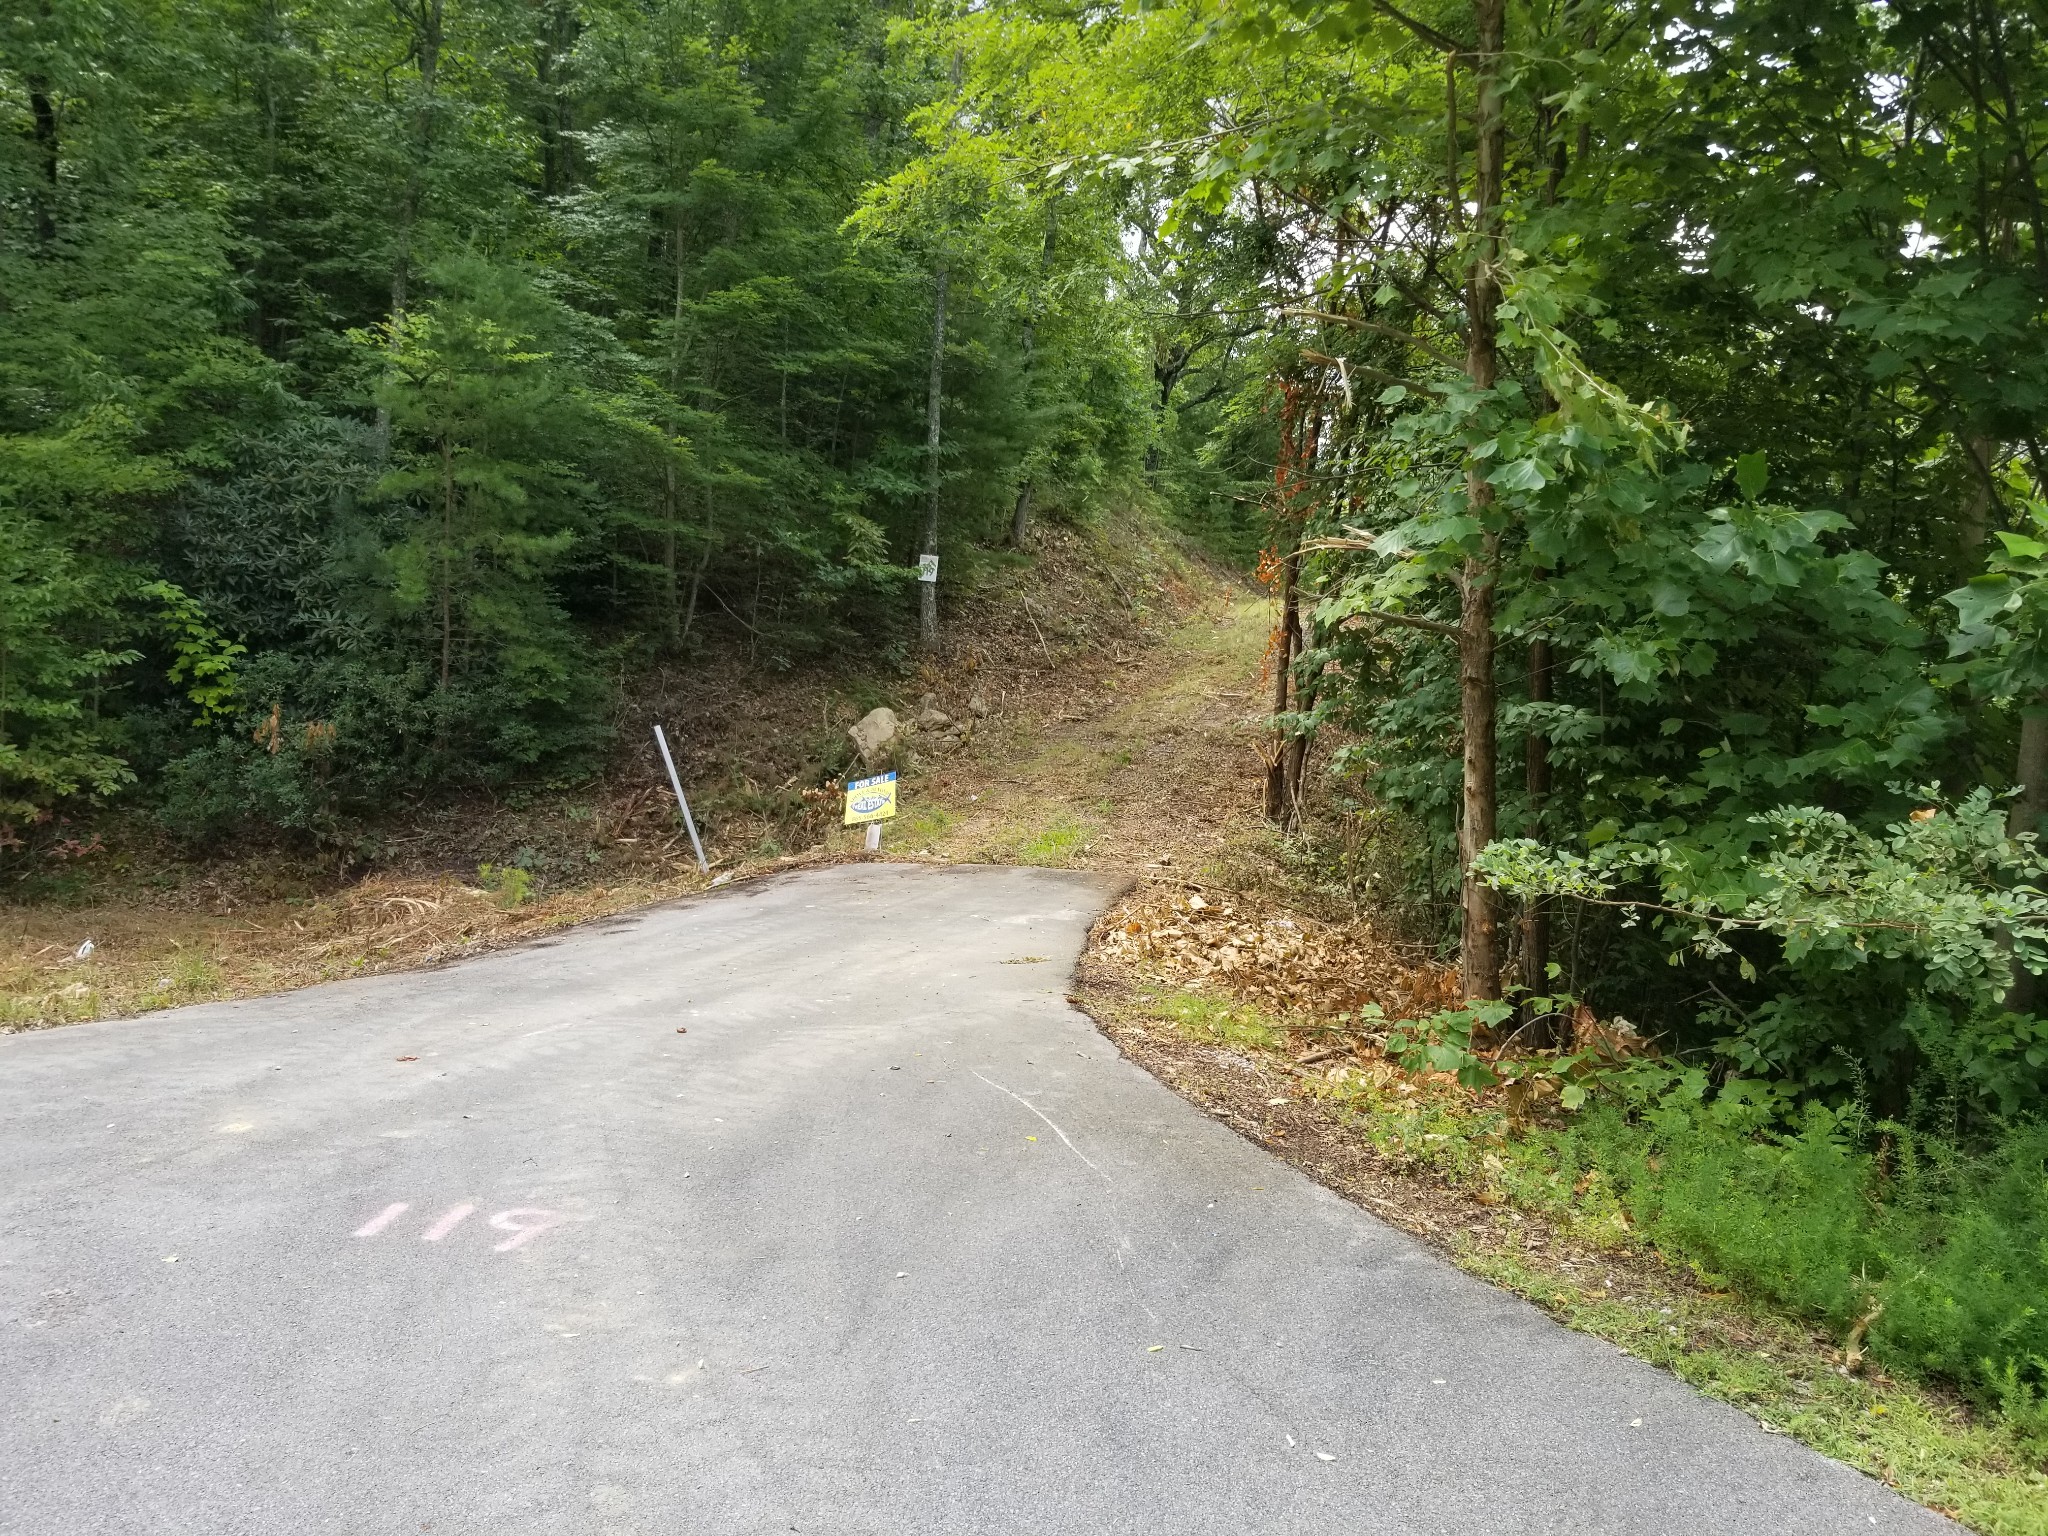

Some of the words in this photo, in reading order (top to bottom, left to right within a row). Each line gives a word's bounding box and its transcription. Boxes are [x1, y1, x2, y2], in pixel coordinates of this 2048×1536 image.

[854, 779, 870, 790] FOR
[871, 774, 890, 786] SALE
[352, 1201, 558, 1251] 119
